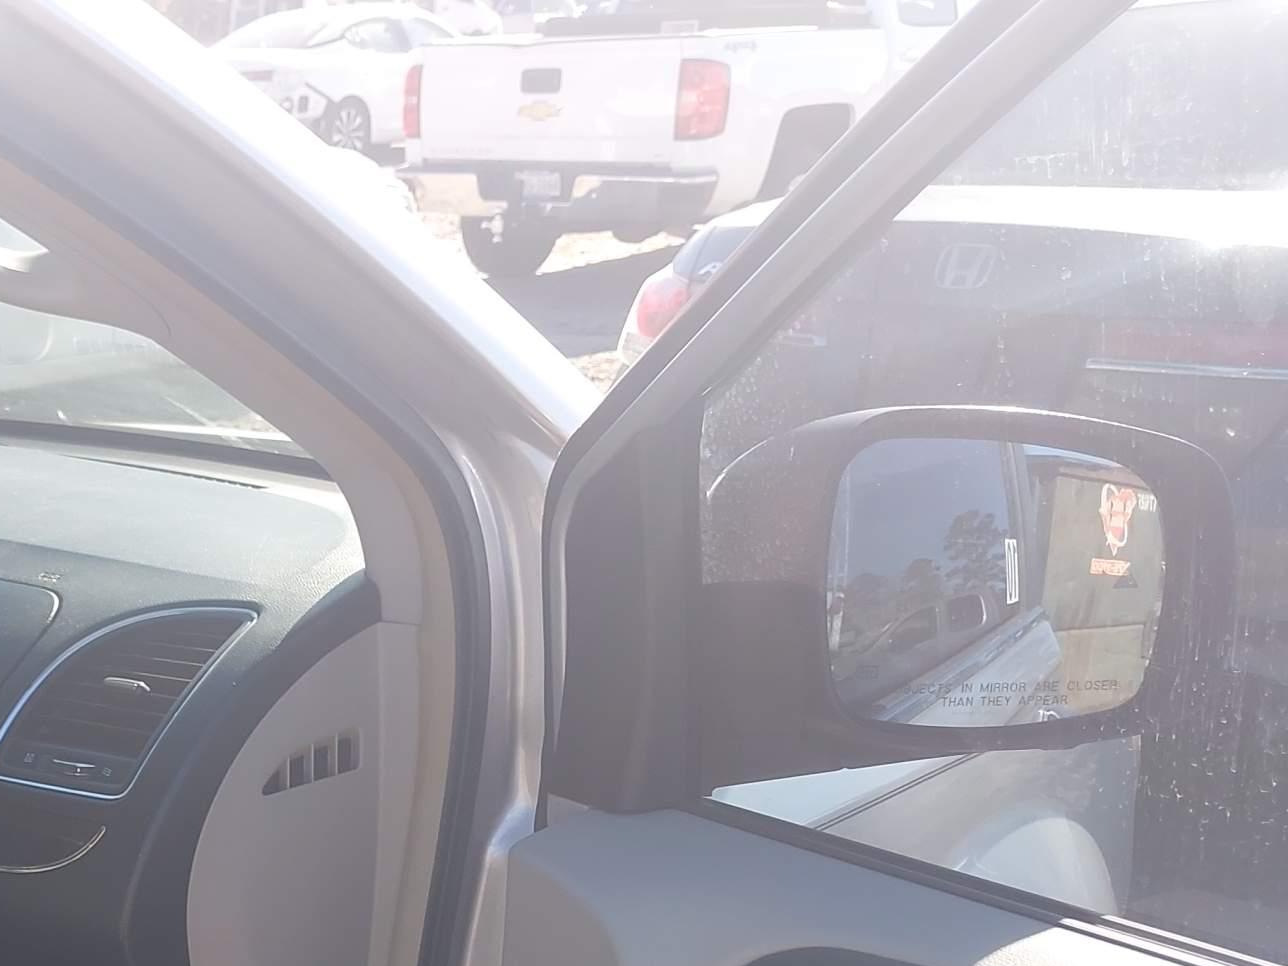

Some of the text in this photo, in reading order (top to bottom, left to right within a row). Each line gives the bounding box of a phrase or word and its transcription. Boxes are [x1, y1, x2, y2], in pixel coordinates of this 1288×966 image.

[896, 680, 1118, 695] BJECTS IN MIRROR ARE CLOSER
[942, 695, 1069, 707] THAN THEY APPEAR
